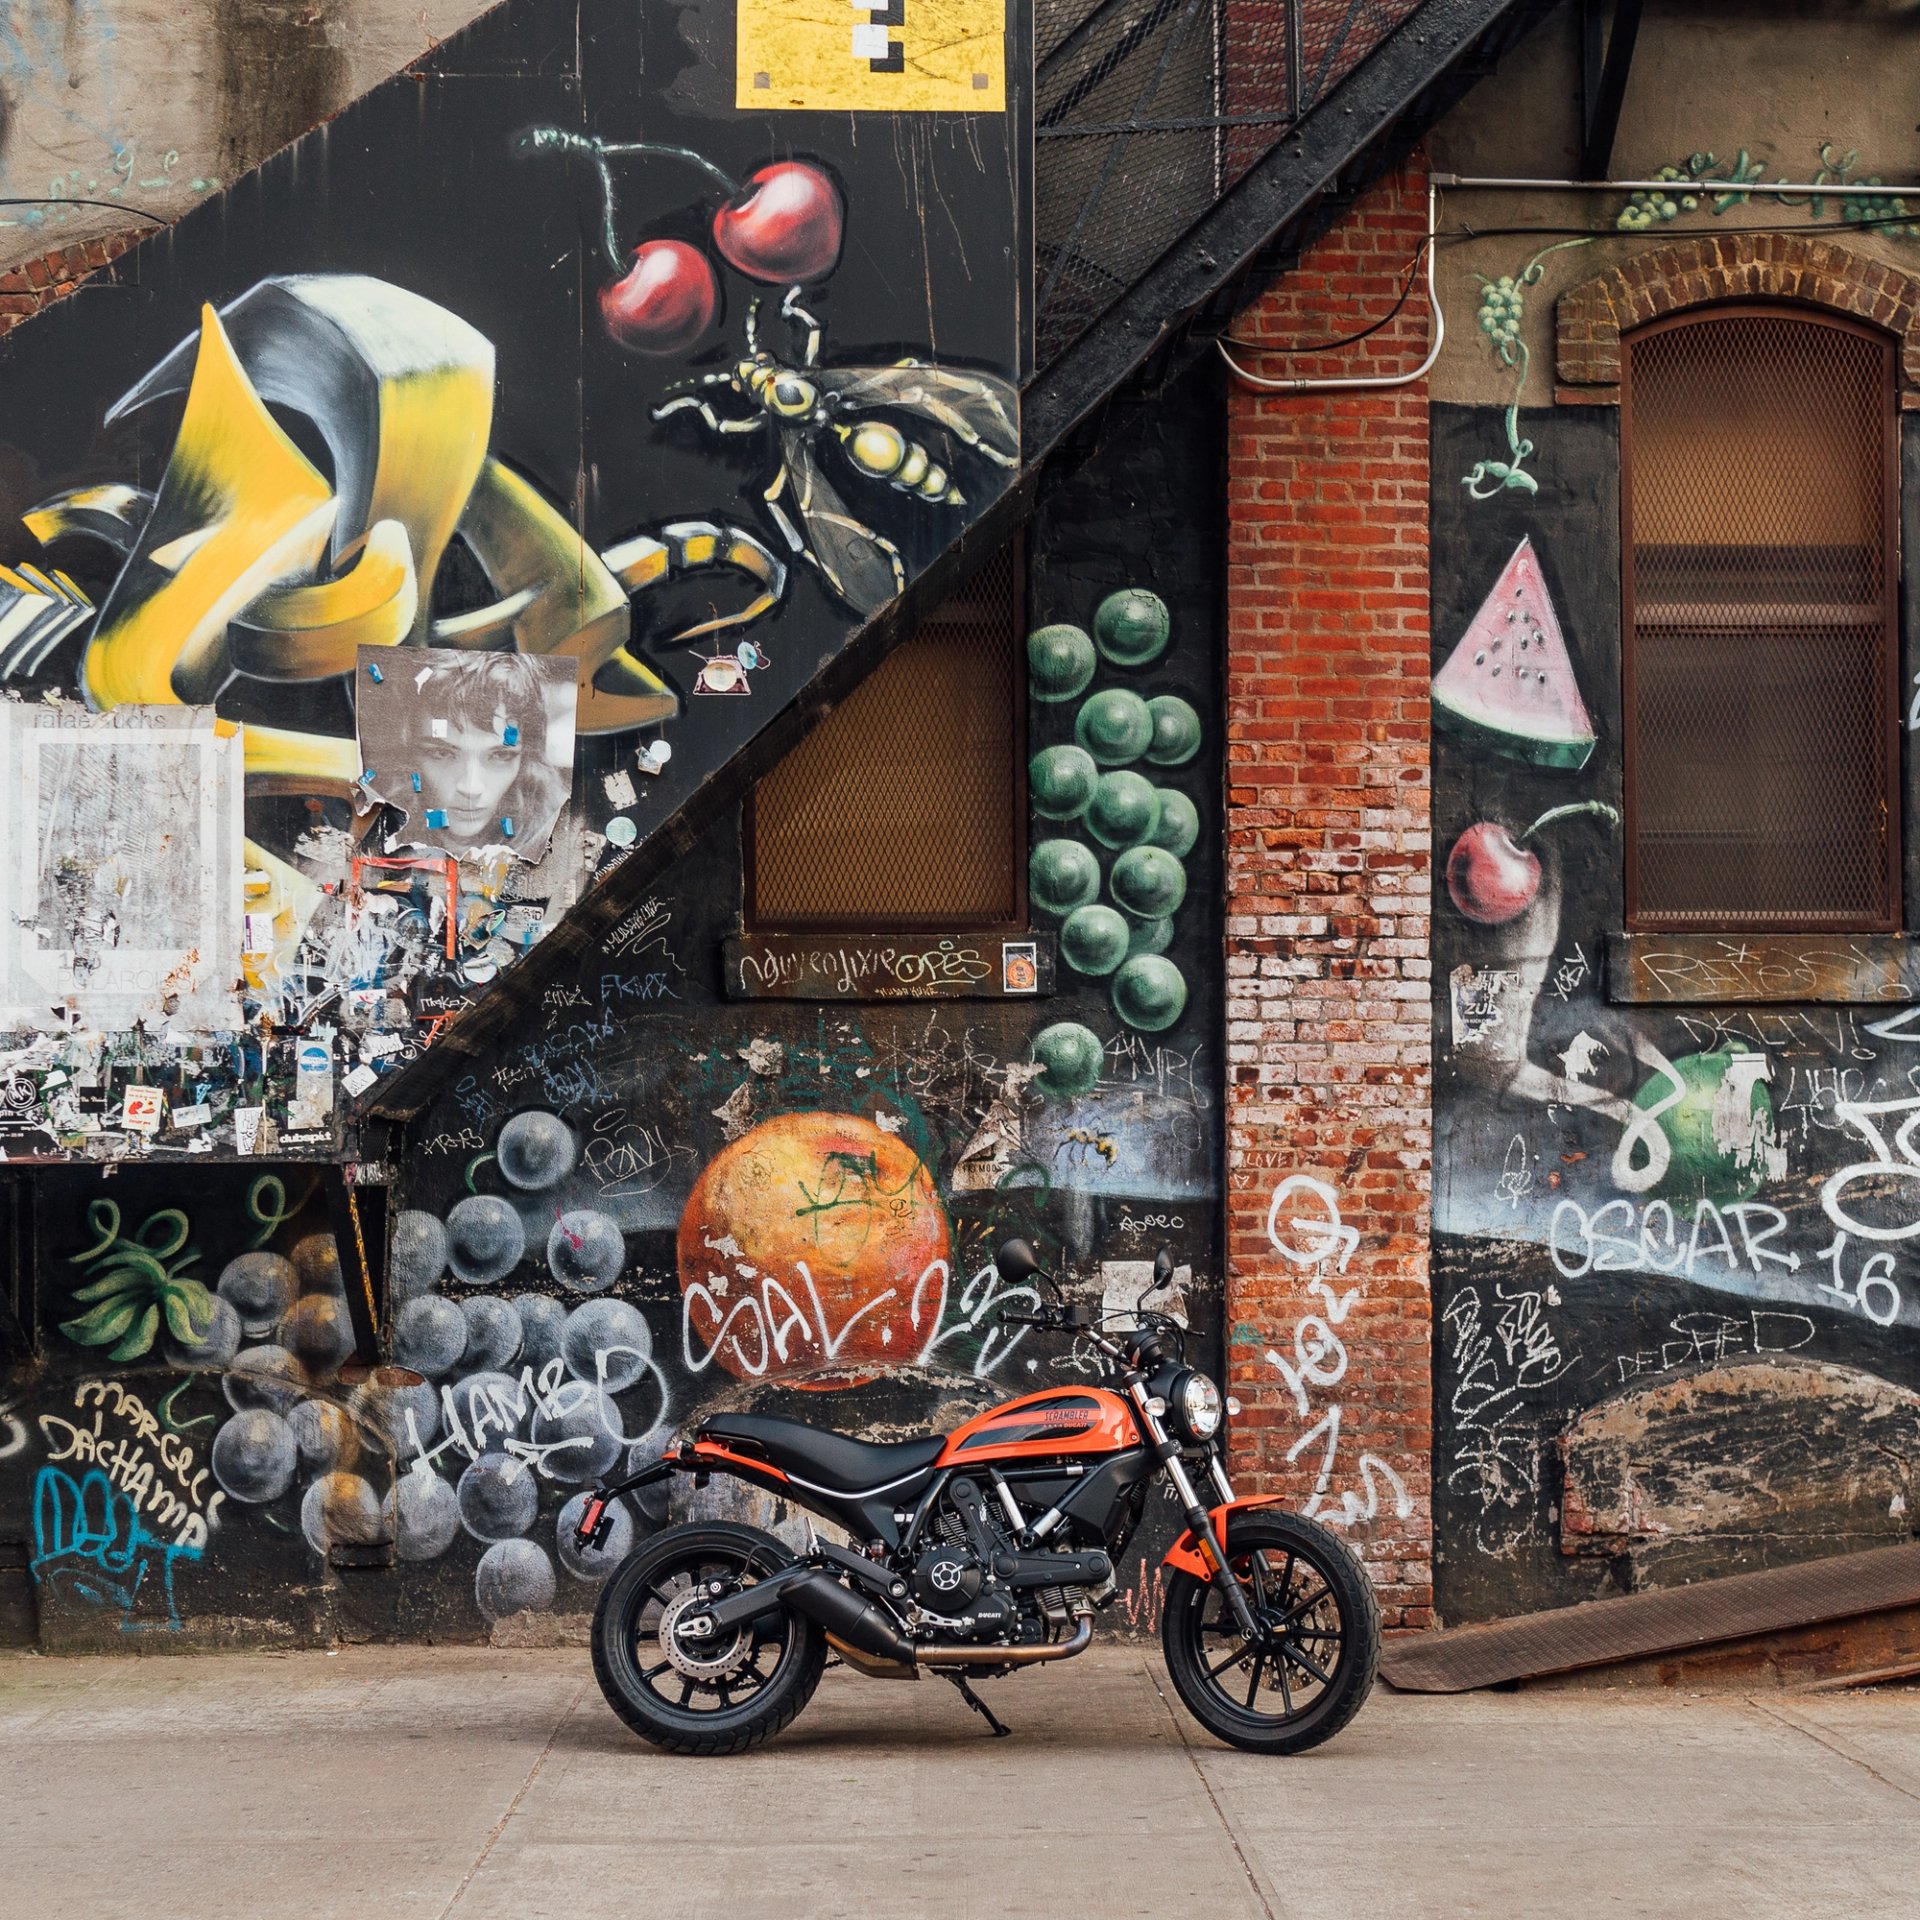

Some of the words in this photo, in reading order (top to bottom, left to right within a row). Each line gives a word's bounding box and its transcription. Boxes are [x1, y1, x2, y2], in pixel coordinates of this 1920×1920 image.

[34, 709, 98, 729] rafae
[107, 708, 167, 729] uchs
[1245, 1152, 1288, 1168] LOVE
[1550, 1199, 1801, 1280] OSCAR
[1816, 1231, 1901, 1327] 16
[1044, 1410, 1089, 1421] SCRAMBLER
